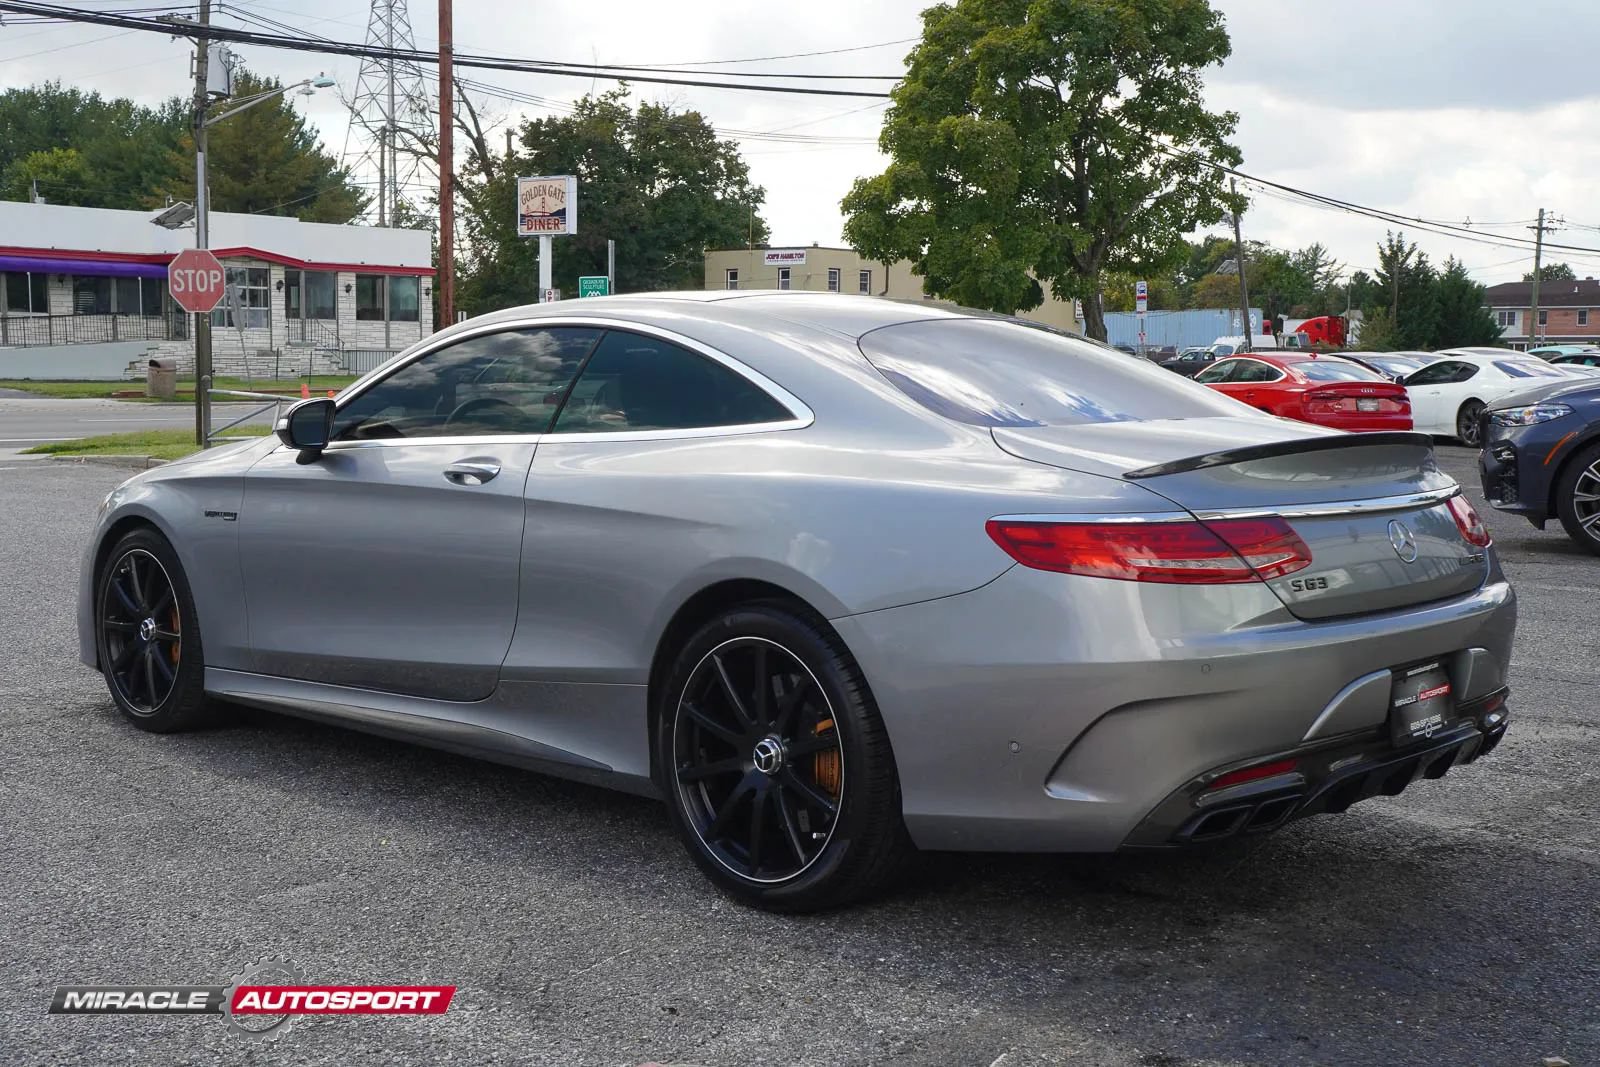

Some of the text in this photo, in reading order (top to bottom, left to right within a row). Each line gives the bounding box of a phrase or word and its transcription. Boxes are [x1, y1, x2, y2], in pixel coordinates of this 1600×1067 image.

[521, 184, 565, 205] GOLDEN GATE
[526, 218, 561, 231] DINER
[173, 269, 221, 293] STOP
[1394, 685, 1449, 707] MIRACLE AUTOSPORT
